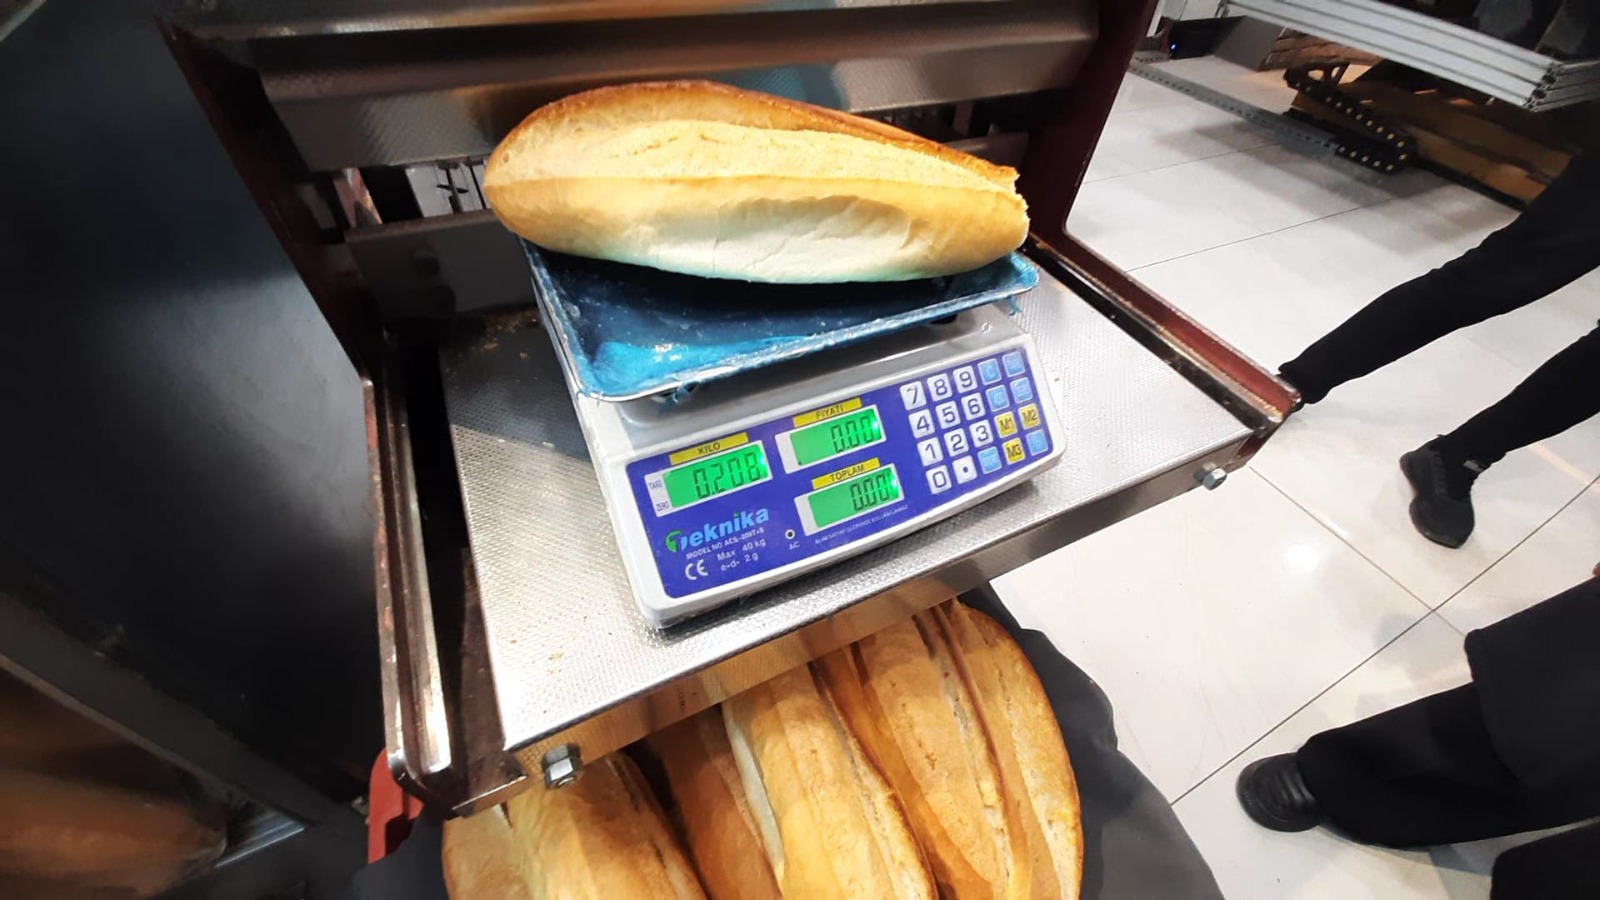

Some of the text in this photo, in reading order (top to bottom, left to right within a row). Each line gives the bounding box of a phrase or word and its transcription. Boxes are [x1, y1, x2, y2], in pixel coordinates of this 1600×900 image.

[906, 387, 918, 404] 7
[934, 378, 948, 397] 8
[959, 371, 973, 388] 9
[916, 415, 930, 432] 4
[942, 406, 956, 424] 5
[967, 398, 981, 415] 6
[698, 441, 721, 454] KILO
[830, 415, 875, 454] 0.00
[924, 409, 1039, 460] 1 2 3 M1 M2
[692, 451, 761, 499] 0.208
[830, 464, 865, 482] TOPLAM
[932, 470, 947, 488] 0
[1006, 443, 1022, 458] M3
[686, 547, 711, 560] MODEL
[711, 541, 723, 552] NO
[716, 538, 766, 561] Max 40 kg
[744, 554, 751, 563] 2
[752, 553, 759, 562] g
[789, 541, 800, 551] AC
